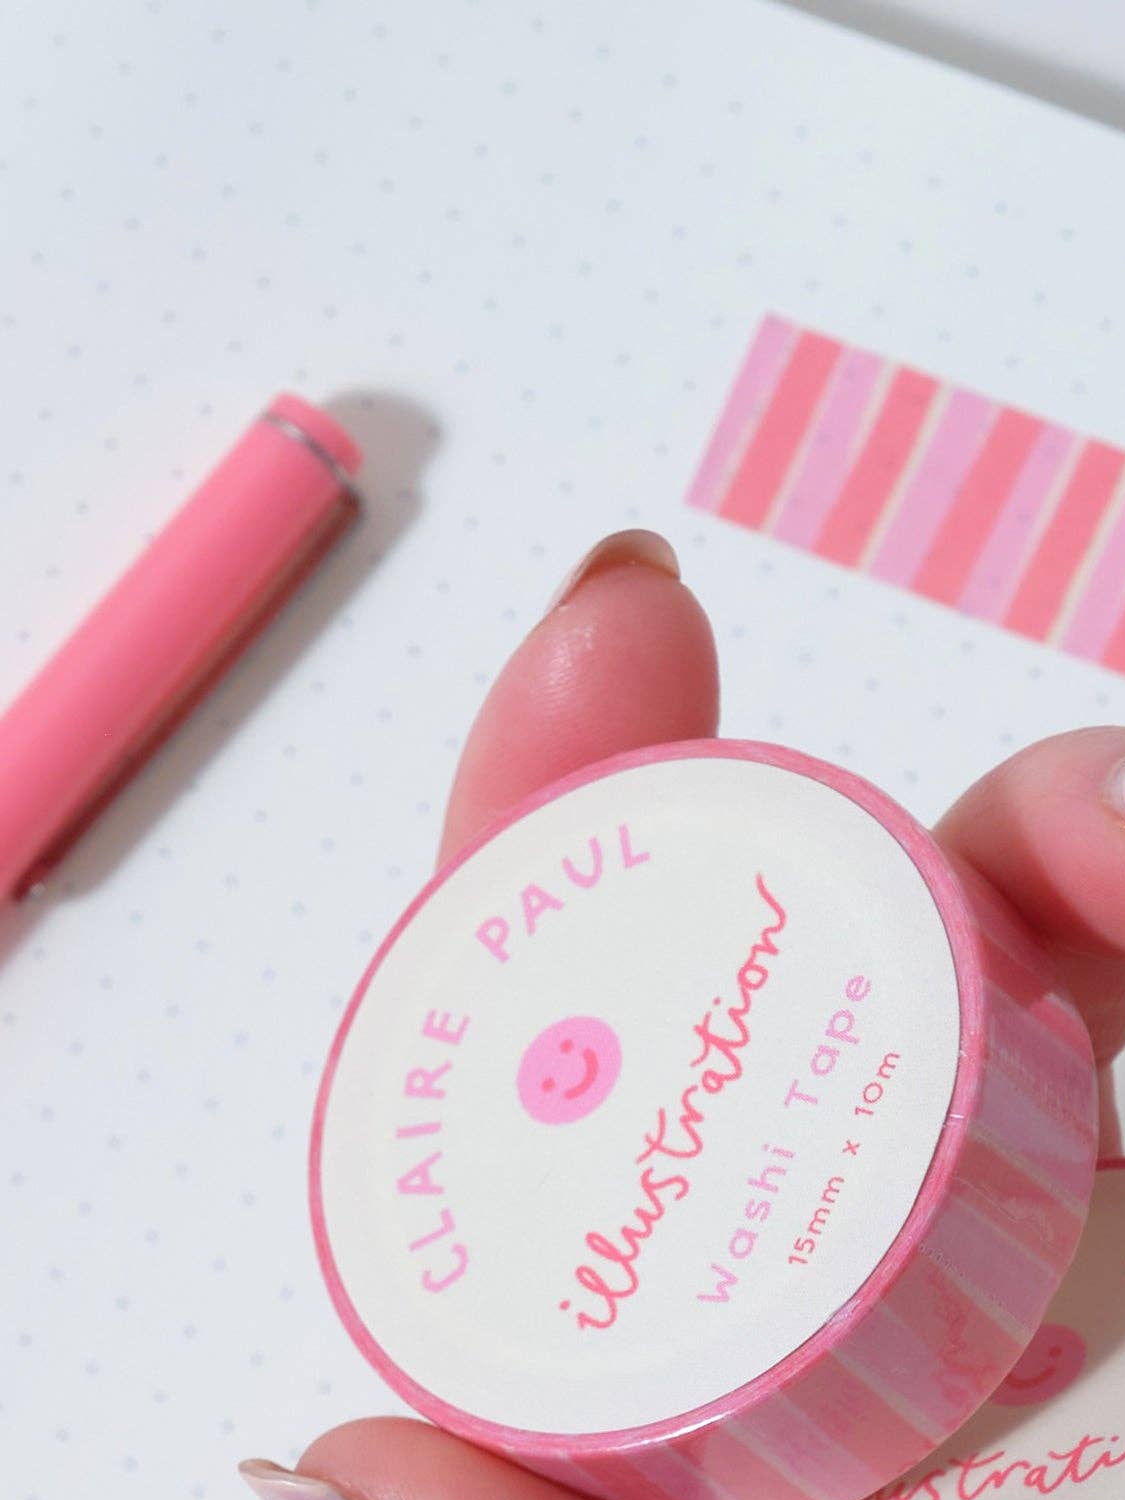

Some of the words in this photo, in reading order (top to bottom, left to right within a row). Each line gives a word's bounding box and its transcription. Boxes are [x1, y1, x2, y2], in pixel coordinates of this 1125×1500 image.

[395, 1008, 470, 1294] CLAIRE
[475, 823, 651, 963] PAUL
[559, 872, 787, 1330] illustration
[697, 1143, 795, 1304] Washi
[783, 974, 871, 1106] Tape
[787, 1176, 843, 1265] 15mm
[843, 1141, 859, 1156] x
[853, 1052, 900, 1116] 10m
